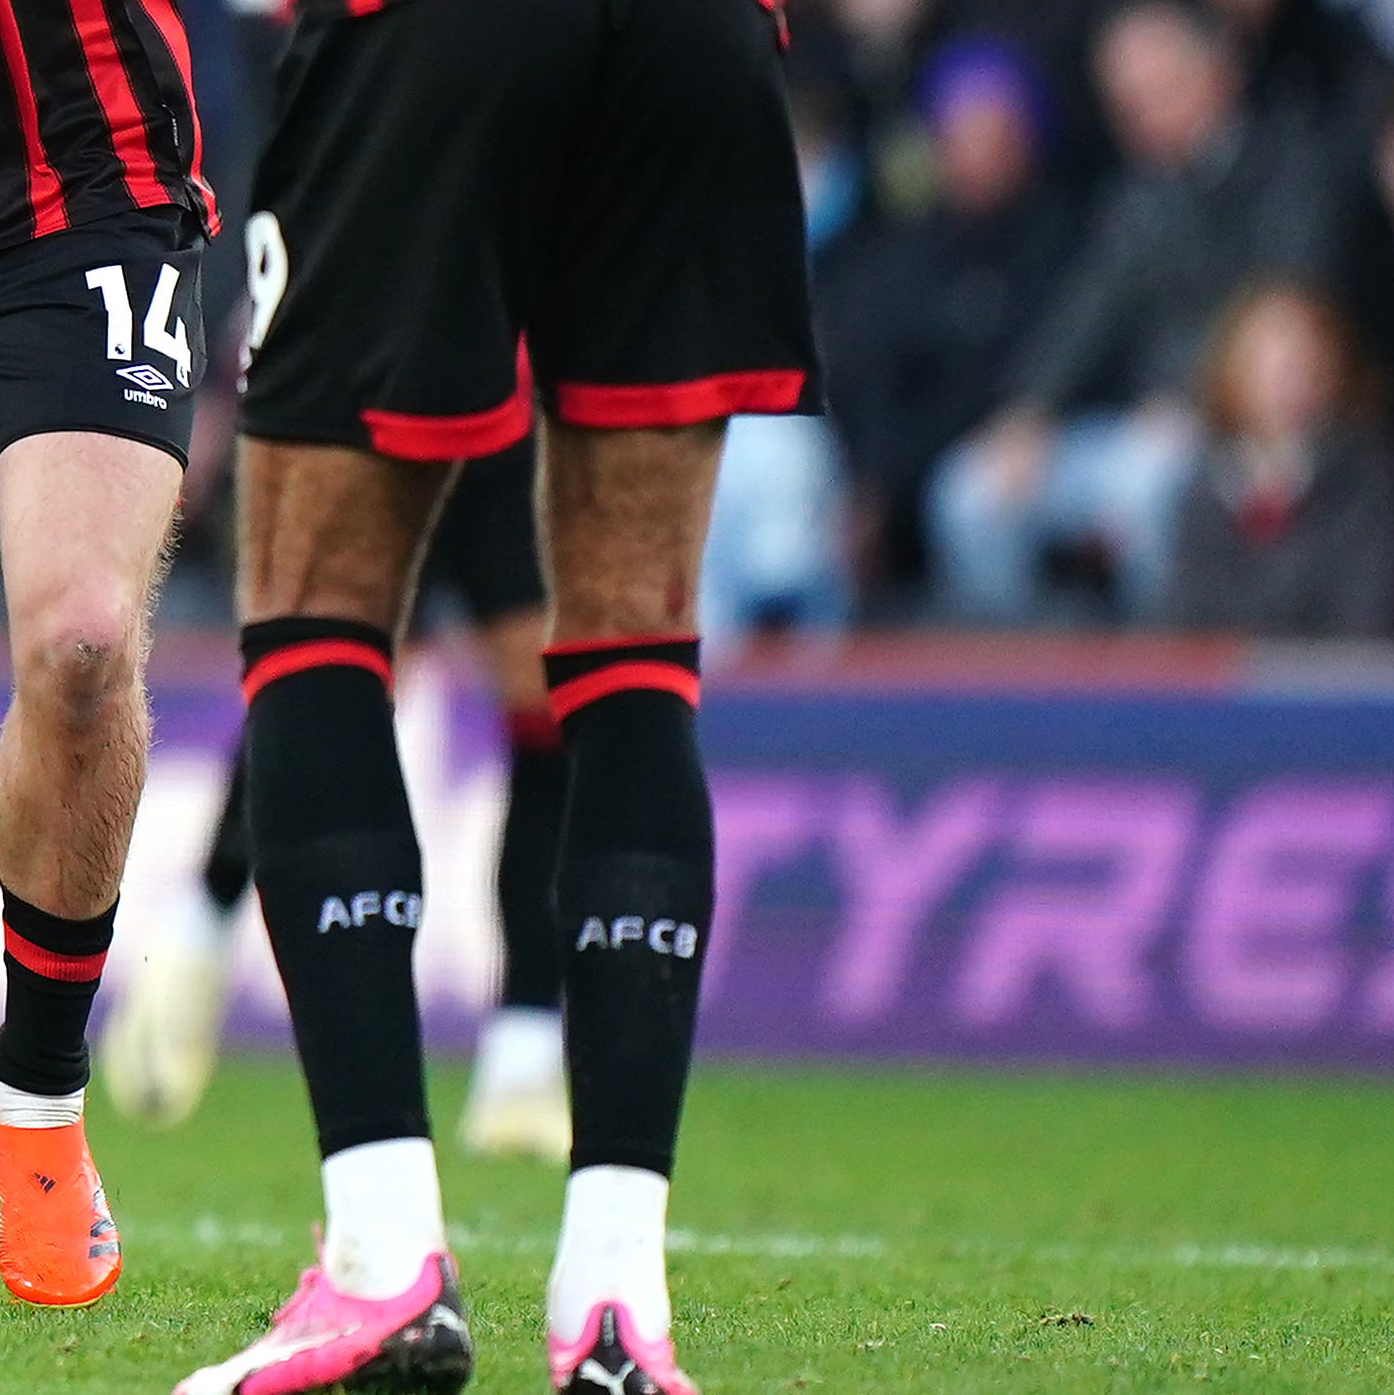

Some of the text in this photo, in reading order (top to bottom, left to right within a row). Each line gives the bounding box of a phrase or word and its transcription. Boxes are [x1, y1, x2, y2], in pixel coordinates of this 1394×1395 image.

[85, 262, 192, 388] 14
[243, 210, 289, 350] 9
[124, 389, 168, 410] umbro
[575, 914, 698, 959] AFCB
[703, 772, 1394, 1031] TYRE
